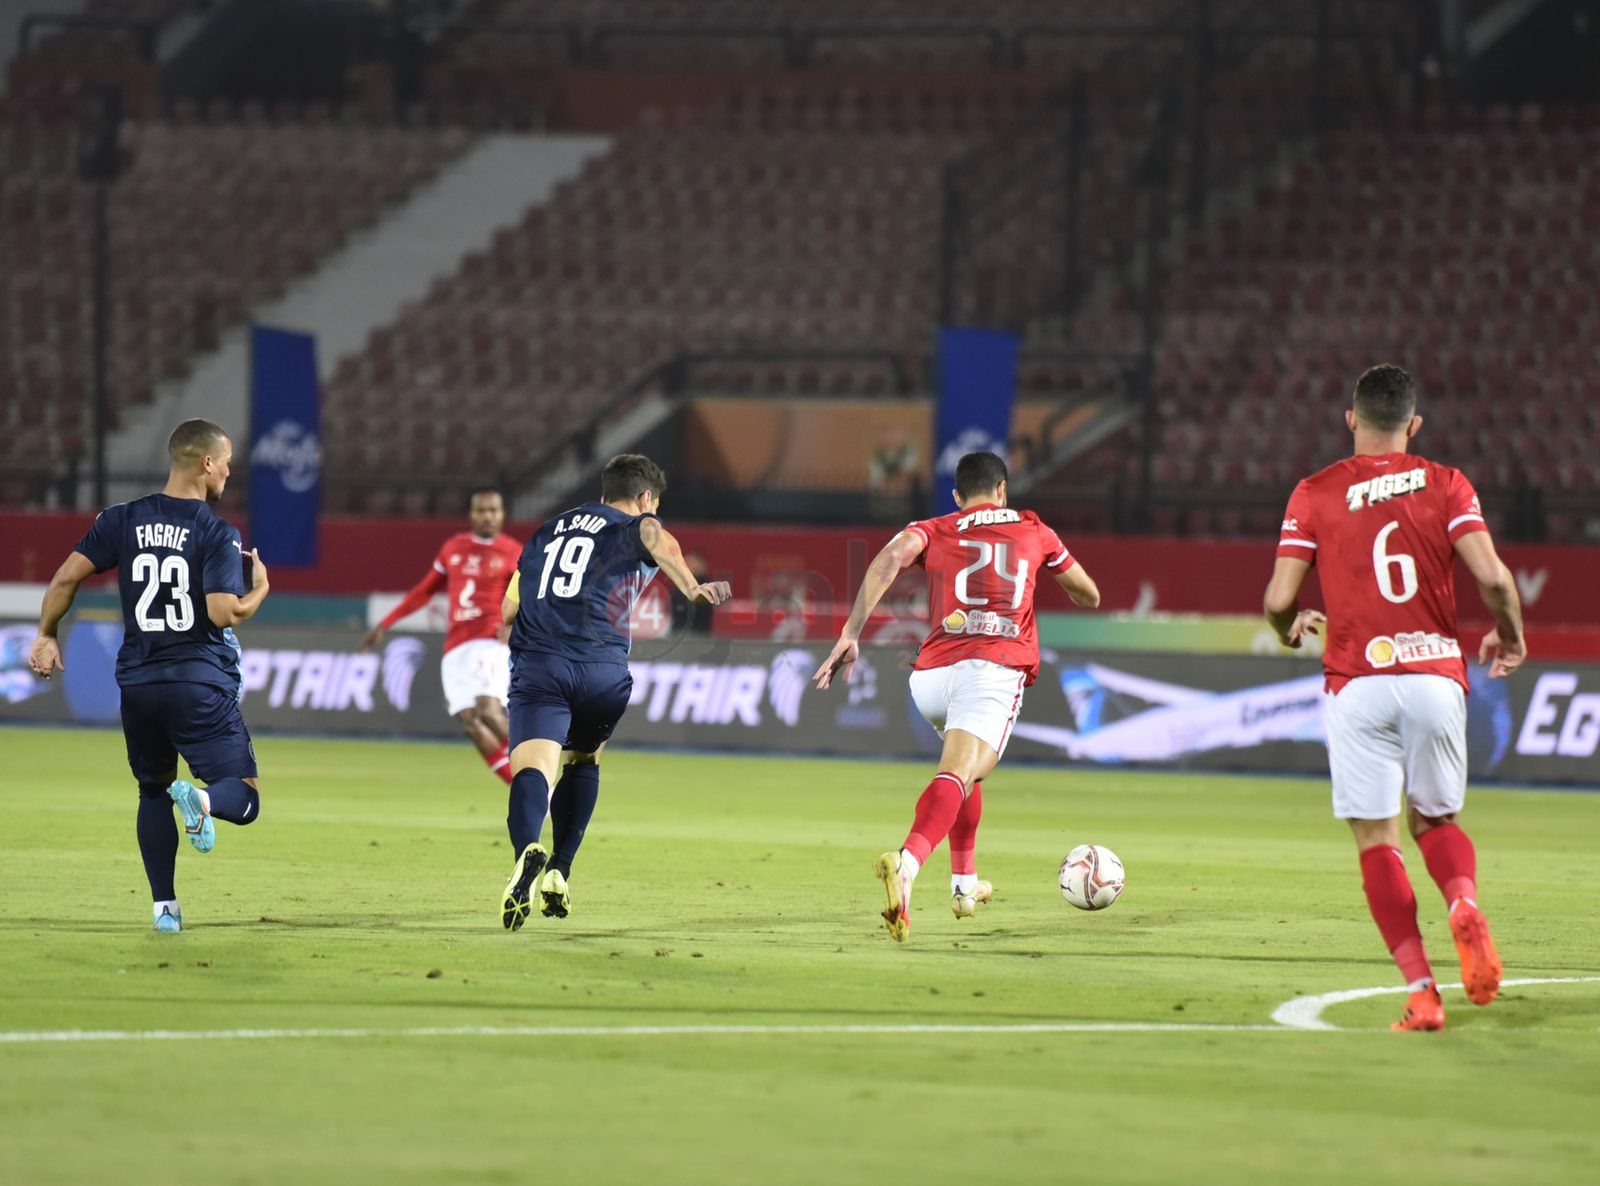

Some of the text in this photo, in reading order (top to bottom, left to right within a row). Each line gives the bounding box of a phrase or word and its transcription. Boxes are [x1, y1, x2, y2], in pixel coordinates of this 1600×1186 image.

[1346, 468, 1427, 512] TIGER
[956, 508, 1021, 533] TIGER
[135, 523, 190, 551] FAGRIE
[537, 536, 595, 599] 19
[955, 539, 1029, 609] 24
[1373, 520, 1419, 604] 6
[132, 553, 195, 631] 23
[969, 621, 1017, 636] HELIX
[971, 612, 995, 621] Shell
[1397, 633, 1424, 645] Shell
[1401, 643, 1456, 659] HELIX
